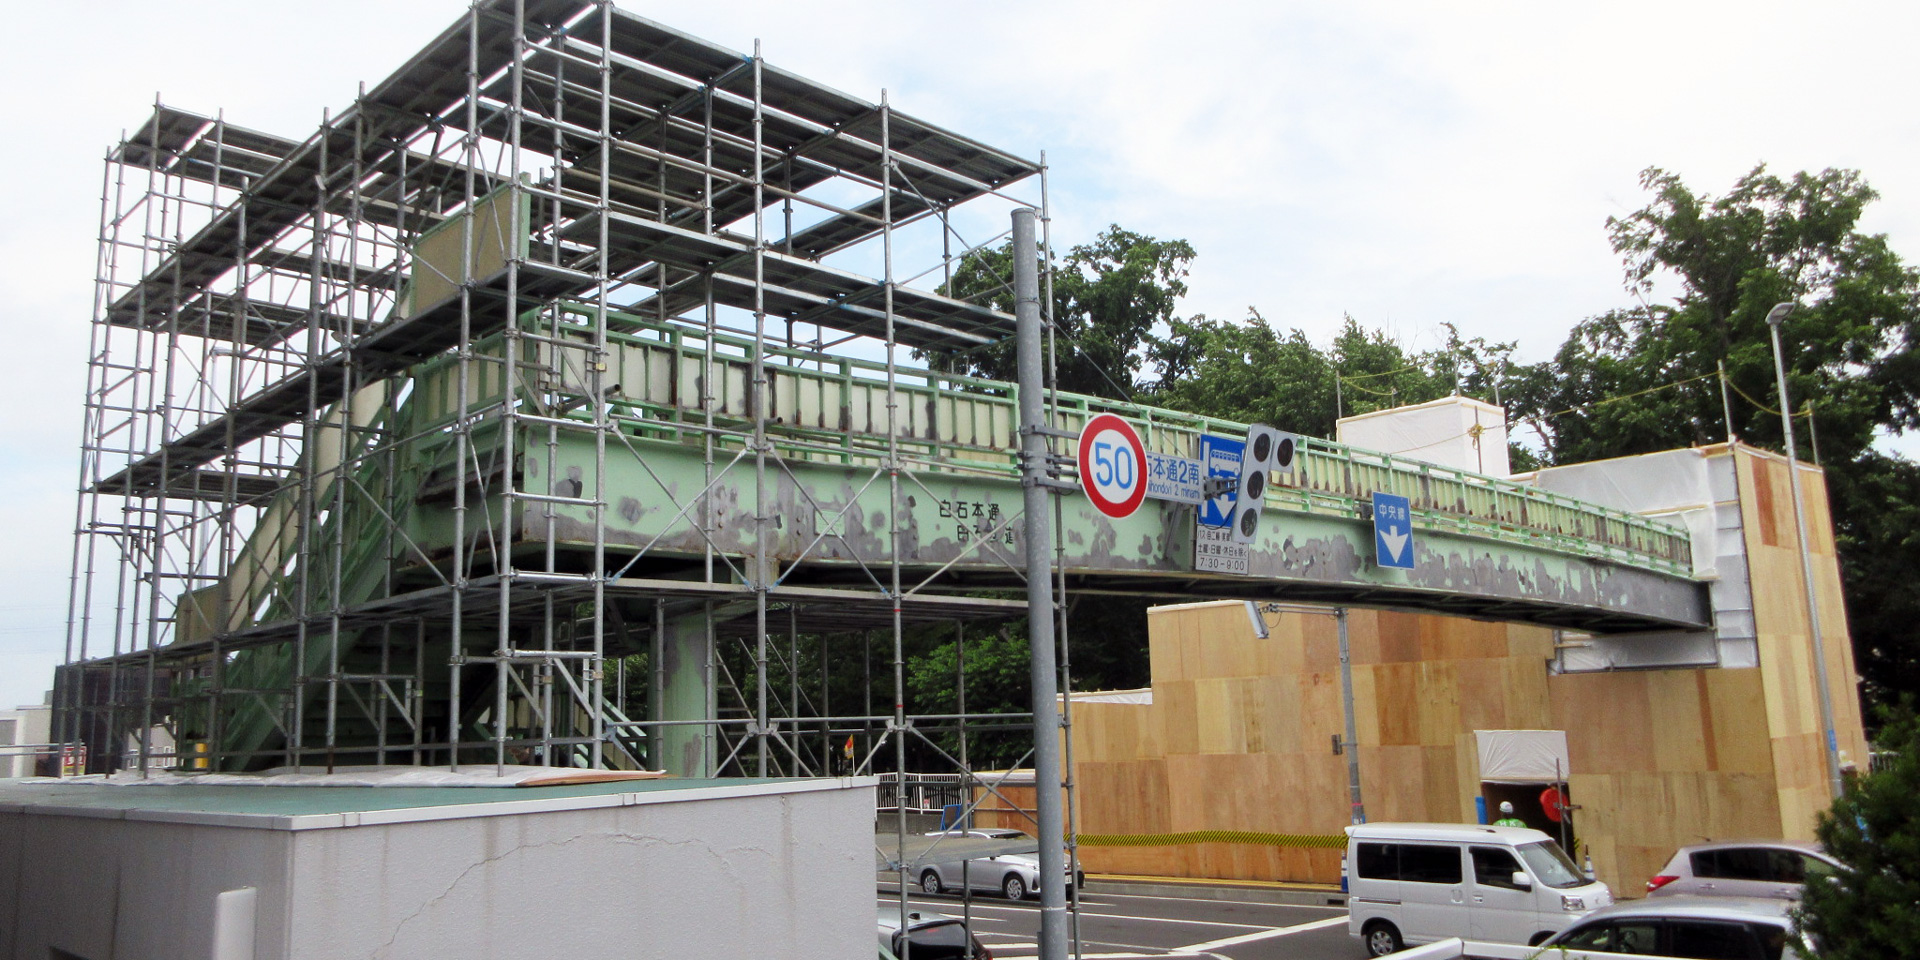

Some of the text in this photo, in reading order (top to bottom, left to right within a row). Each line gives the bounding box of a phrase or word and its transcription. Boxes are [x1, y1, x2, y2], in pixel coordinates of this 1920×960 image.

[1095, 441, 1132, 489] 50
[1174, 483, 1180, 497] 2
[1182, 486, 1200, 499] minami
[939, 499, 999, 520] 白石本通
[1378, 503, 1405, 521] 中央線
